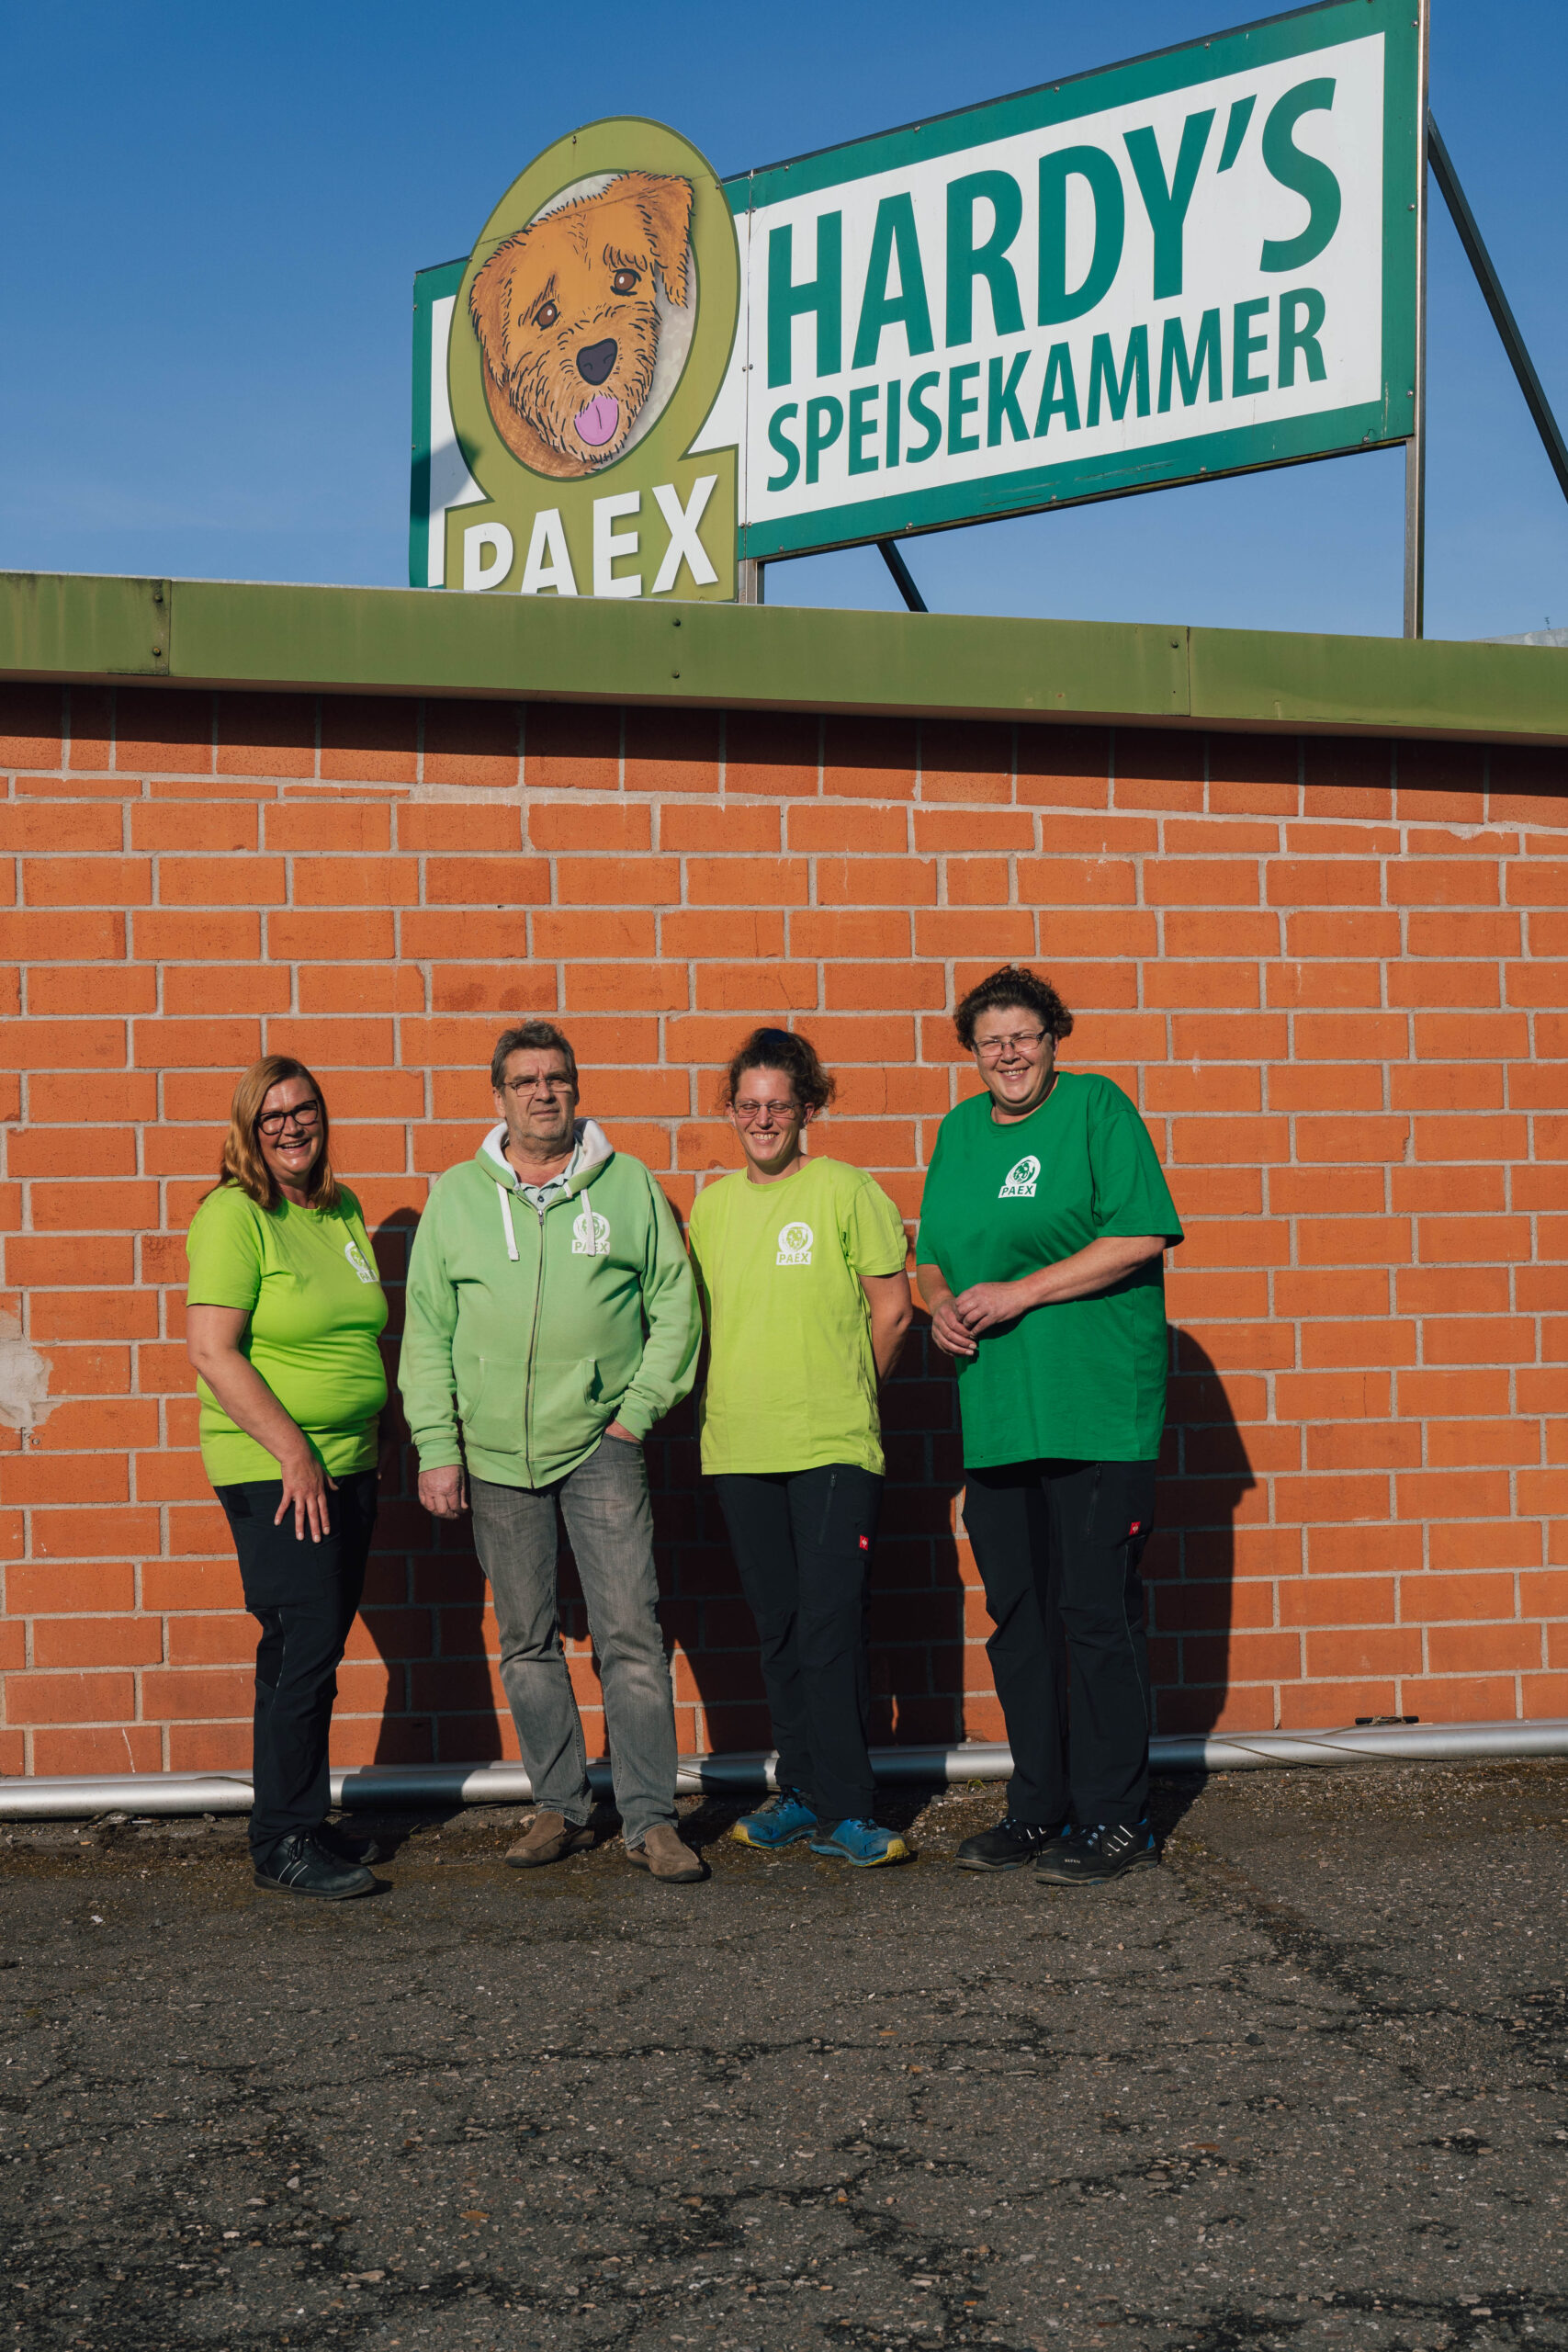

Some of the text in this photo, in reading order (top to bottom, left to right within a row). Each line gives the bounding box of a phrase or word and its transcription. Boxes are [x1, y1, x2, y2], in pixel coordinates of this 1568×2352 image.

[767, 287, 1327, 492] SPEISEKAMMER
[464, 474, 719, 598] PAEX
[1001, 1185, 1034, 1196] PAEX
[778, 1252, 809, 1263] PAEX
